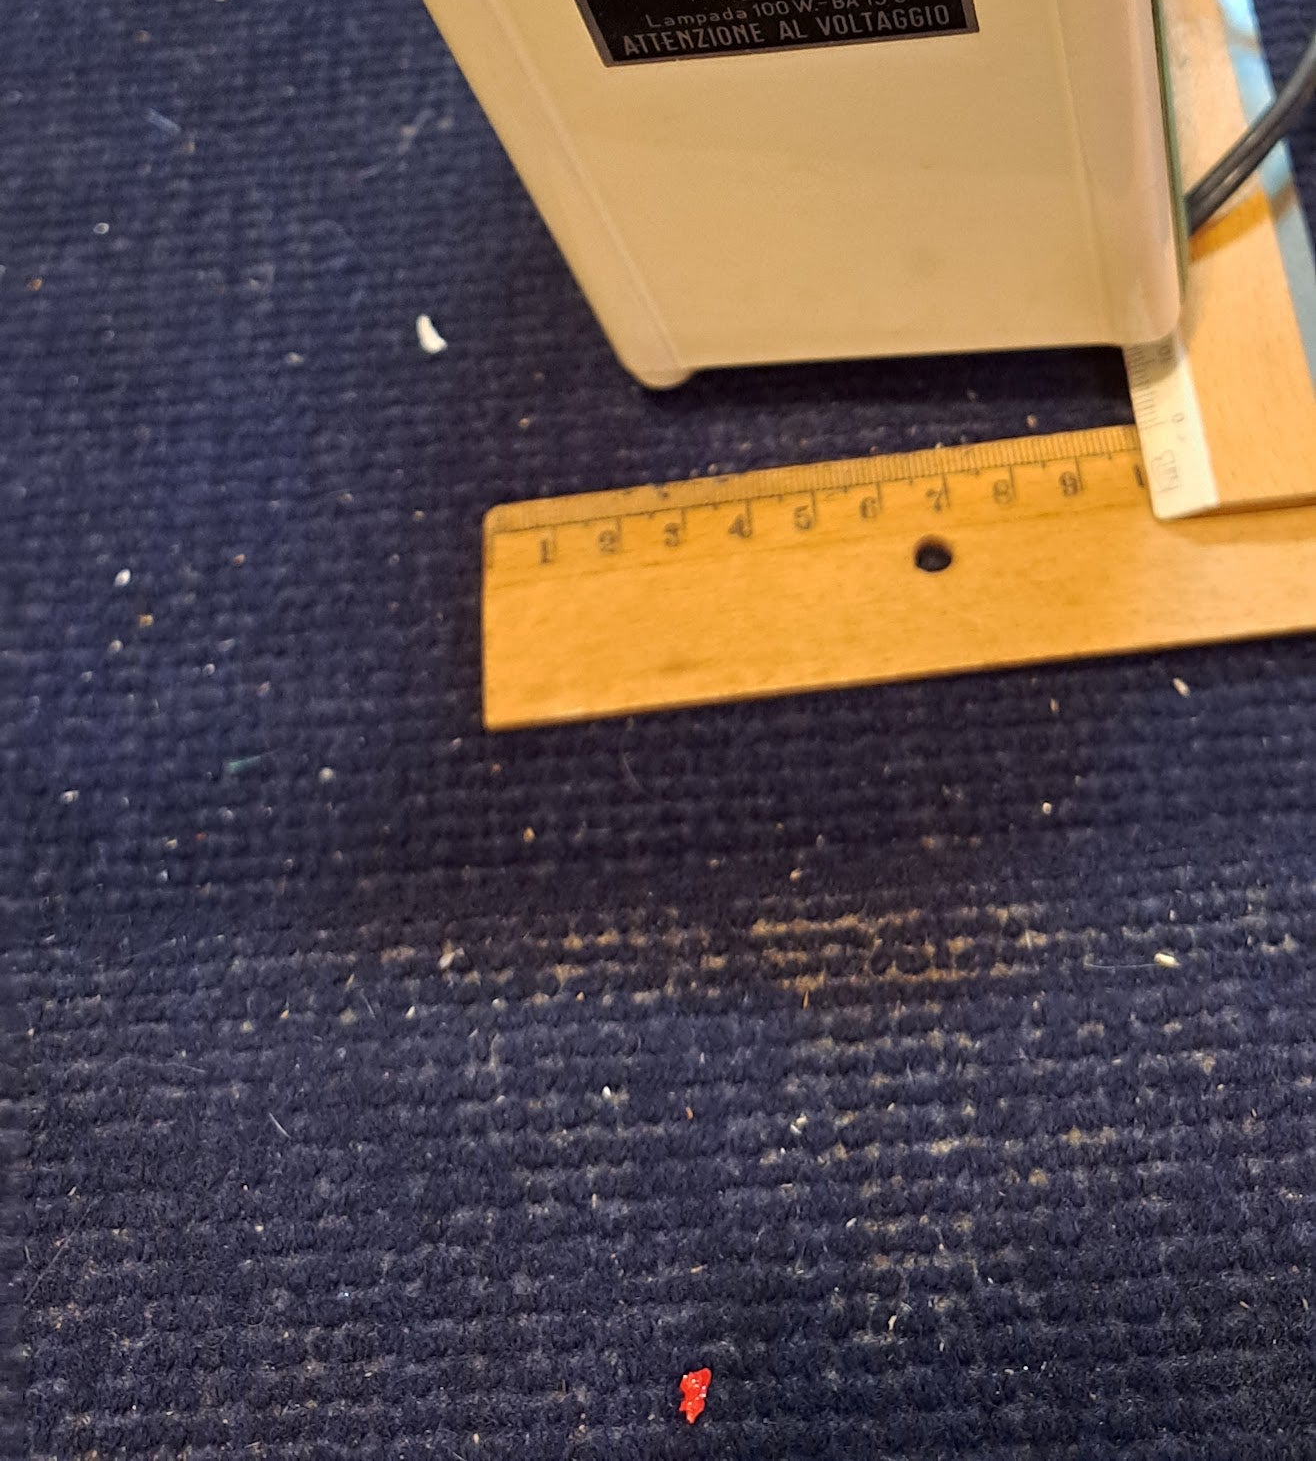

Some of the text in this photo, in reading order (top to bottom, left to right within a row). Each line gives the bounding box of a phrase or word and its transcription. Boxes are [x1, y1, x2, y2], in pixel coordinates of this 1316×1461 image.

[623, 4, 950, 56] ATTENZIONE AL VOLTAGGIO
[645, 8, 748, 28] Lampada
[539, 537, 552, 565] 1
[598, 529, 618, 553] 2
[664, 522, 681, 547] 3
[728, 513, 752, 539] 4
[795, 505, 812, 530] 5
[859, 496, 879, 520] 6
[926, 488, 946, 512] 7
[992, 479, 1013, 505] 8
[1059, 470, 1079, 497] 9
